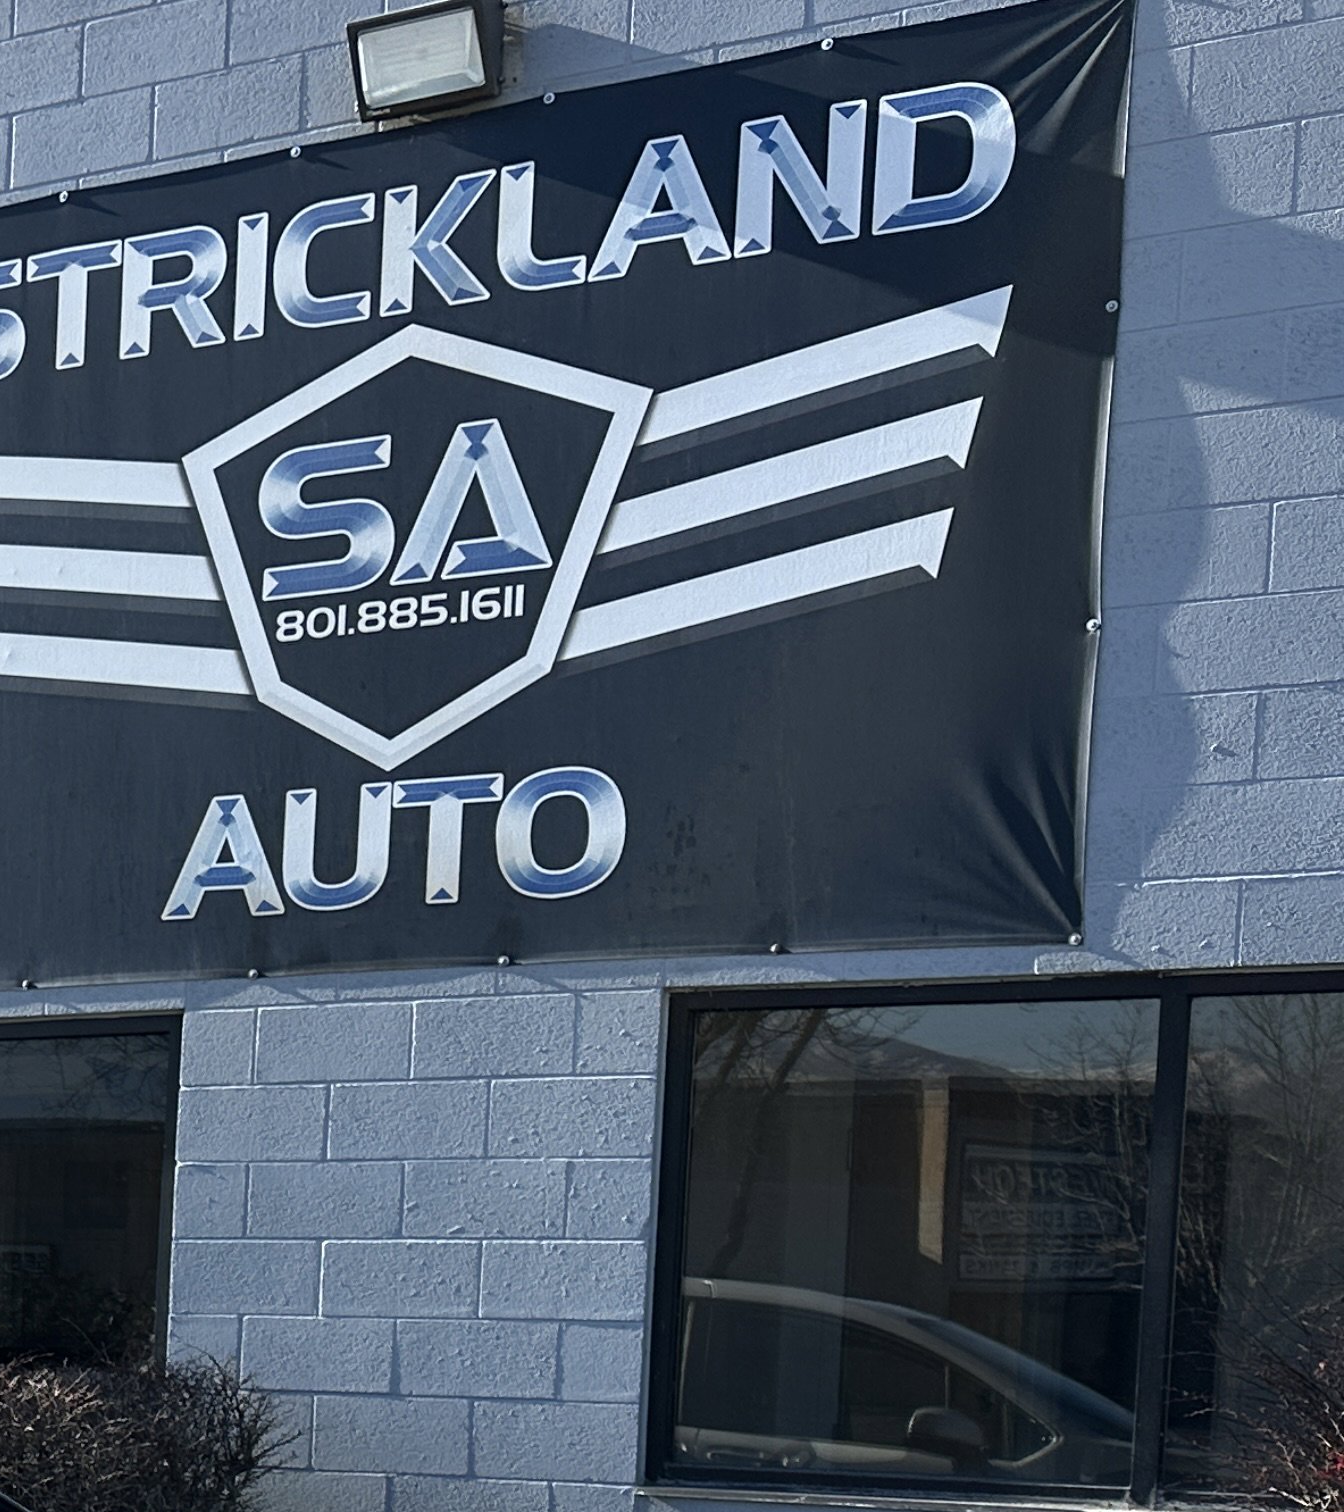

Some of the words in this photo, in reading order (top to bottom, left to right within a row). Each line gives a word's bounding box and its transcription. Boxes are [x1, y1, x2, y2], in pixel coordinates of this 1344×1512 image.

[259, 418, 553, 601] SA
[275, 584, 525, 643] 801.885.1611
[161, 766, 627, 921] AUTO
